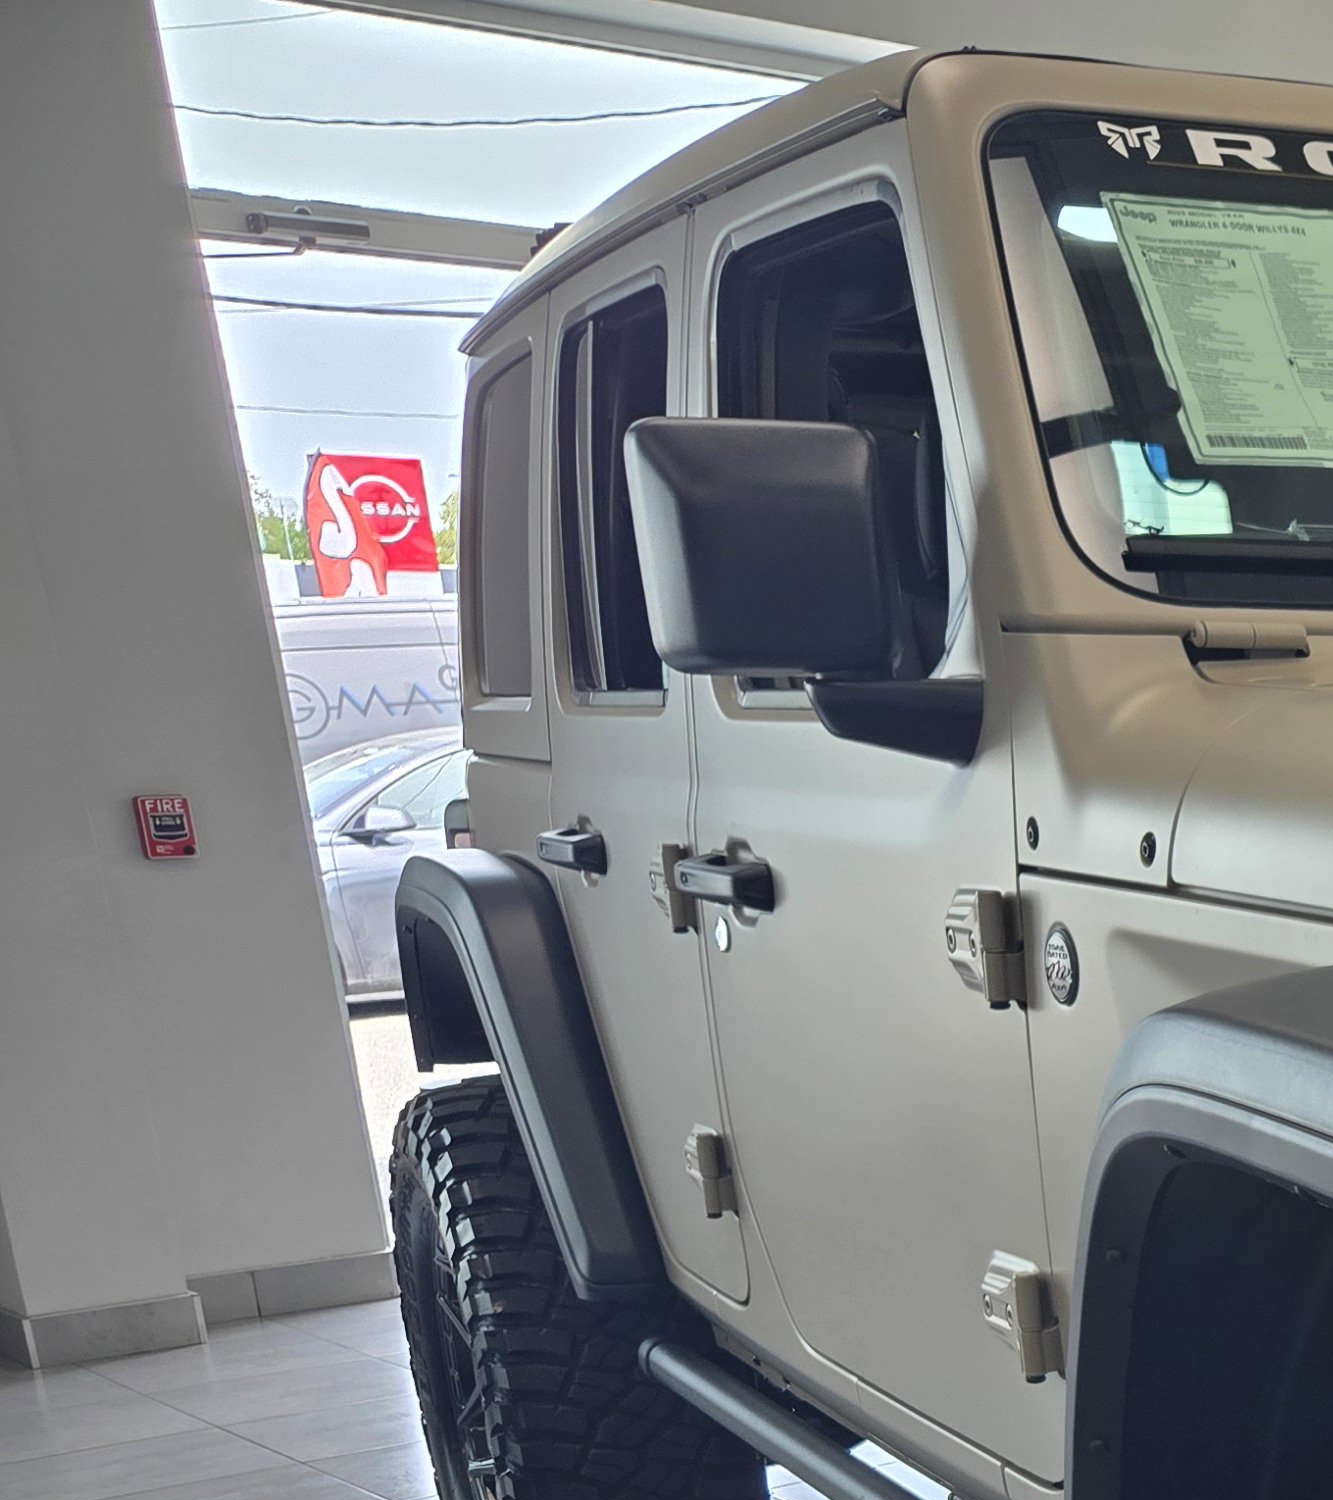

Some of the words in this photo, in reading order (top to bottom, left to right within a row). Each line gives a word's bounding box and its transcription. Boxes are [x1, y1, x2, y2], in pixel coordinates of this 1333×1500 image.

[1119, 205, 1158, 224] Jeep
[1169, 218, 1221, 230] WRANGLER
[360, 501, 420, 517] SSAN
[144, 799, 185, 813] FIRE
